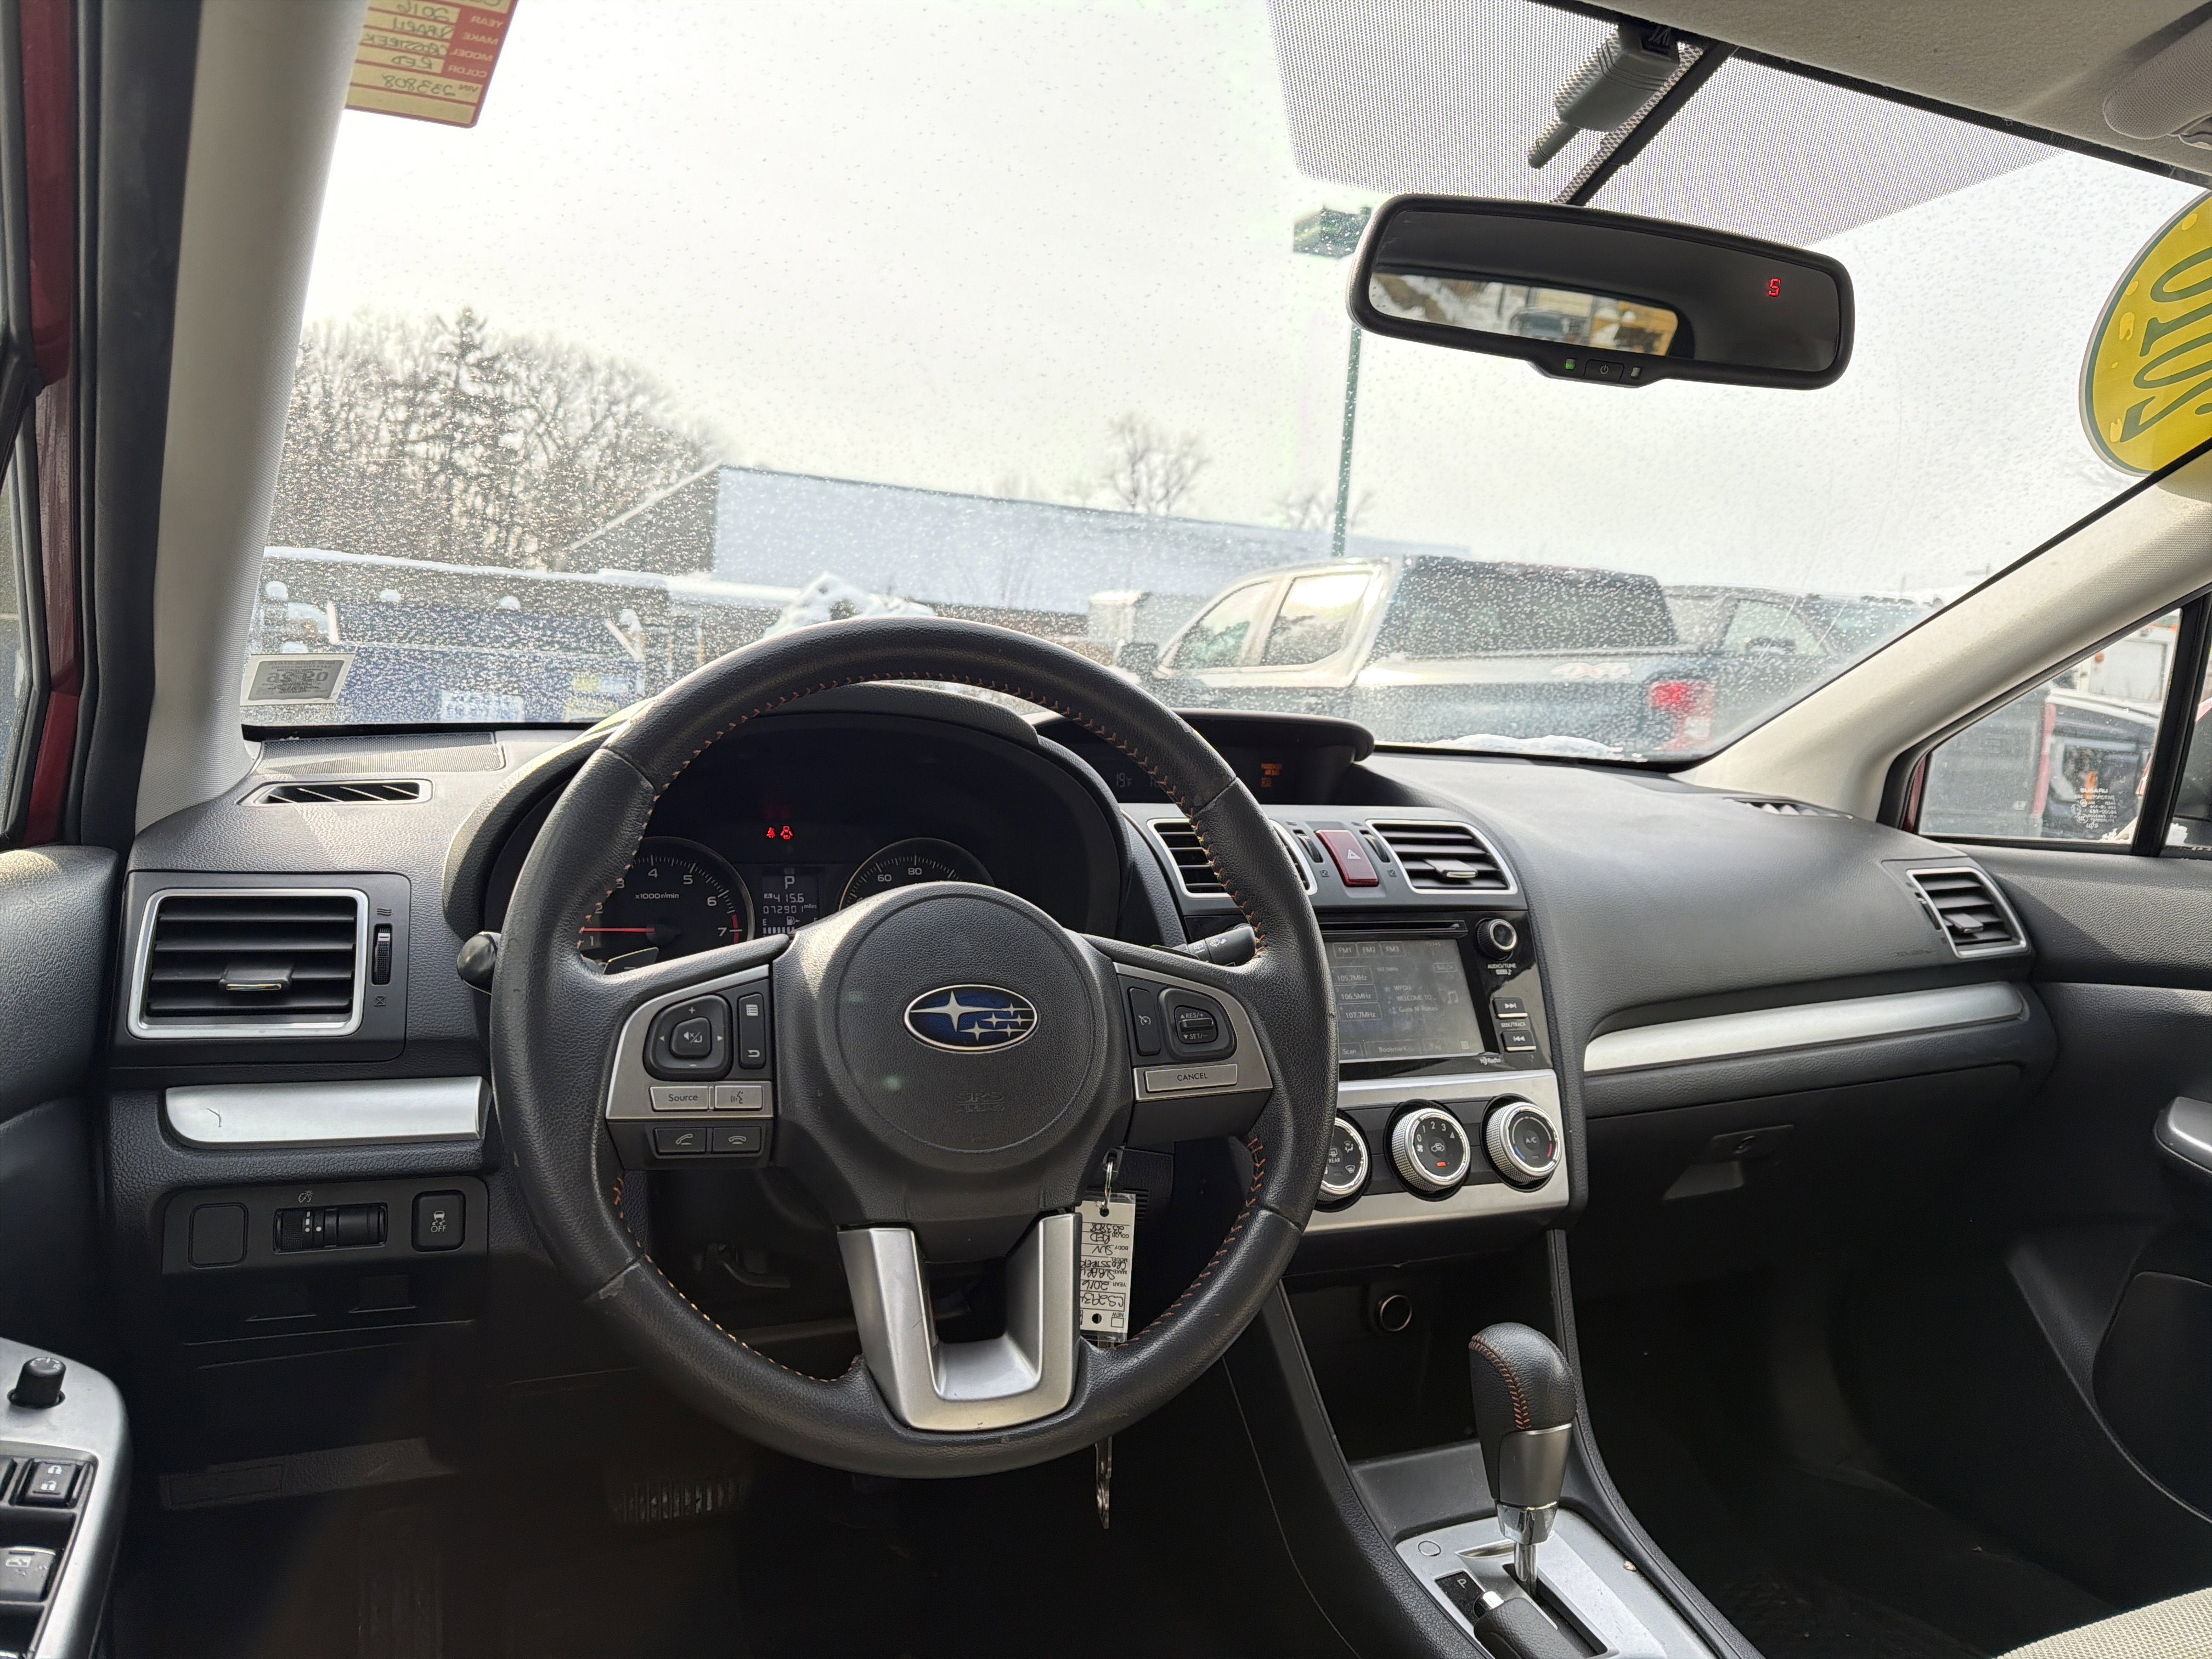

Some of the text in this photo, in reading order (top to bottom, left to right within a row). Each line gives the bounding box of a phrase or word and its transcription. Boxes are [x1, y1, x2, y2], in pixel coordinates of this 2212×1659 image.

[648, 867, 659, 878] 4
[907, 867, 923, 876] 80
[682, 874, 694, 885] 5
[785, 876, 795, 890] P
[877, 874, 892, 882] 60
[707, 896, 717, 906] 6
[763, 905, 804, 915] 072901
[717, 927, 727, 937] 7
[589, 936, 594, 946] 1
[1177, 1073, 1208, 1081] CANCEL
[668, 1093, 698, 1102] Source
[1417, 1133, 1422, 1142] 0
[1422, 1125, 1426, 1133] 1
[1430, 1121, 1436, 1130] 2
[1441, 1123, 1447, 1131] 3
[1525, 1136, 1537, 1144] A/C
[430, 1224, 447, 1233] OFF
[1090, 1232, 1110, 1244] RED
[1456, 1578, 1468, 1589] P
